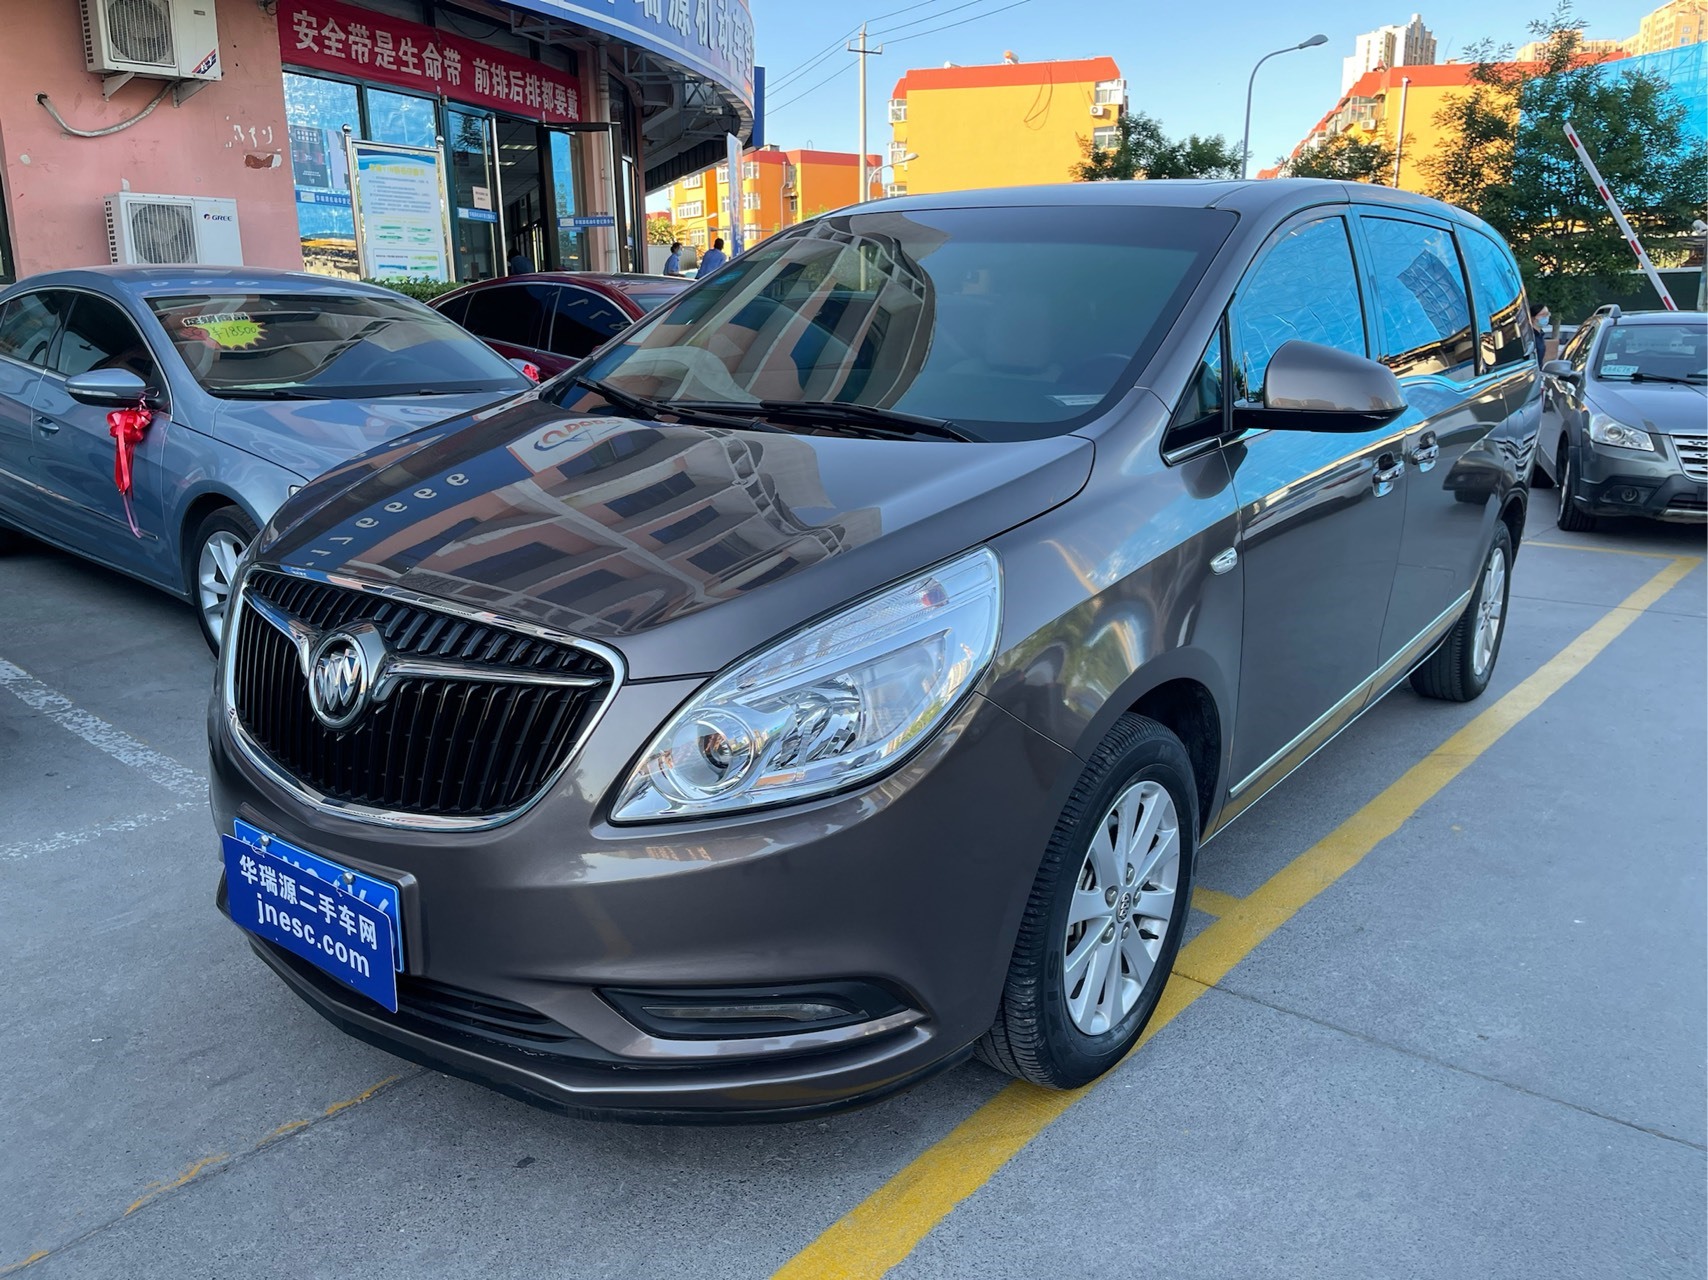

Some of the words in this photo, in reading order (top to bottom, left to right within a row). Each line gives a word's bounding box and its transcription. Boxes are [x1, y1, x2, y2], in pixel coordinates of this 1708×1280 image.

[292, 9, 462, 87] 安全带是生命带
[471, 57, 579, 121] 前排后排都要戴
[211, 214, 233, 222] GREE
[239, 854, 378, 951] 华瑞源二手车网
[256, 893, 370, 978] jnesc.com
